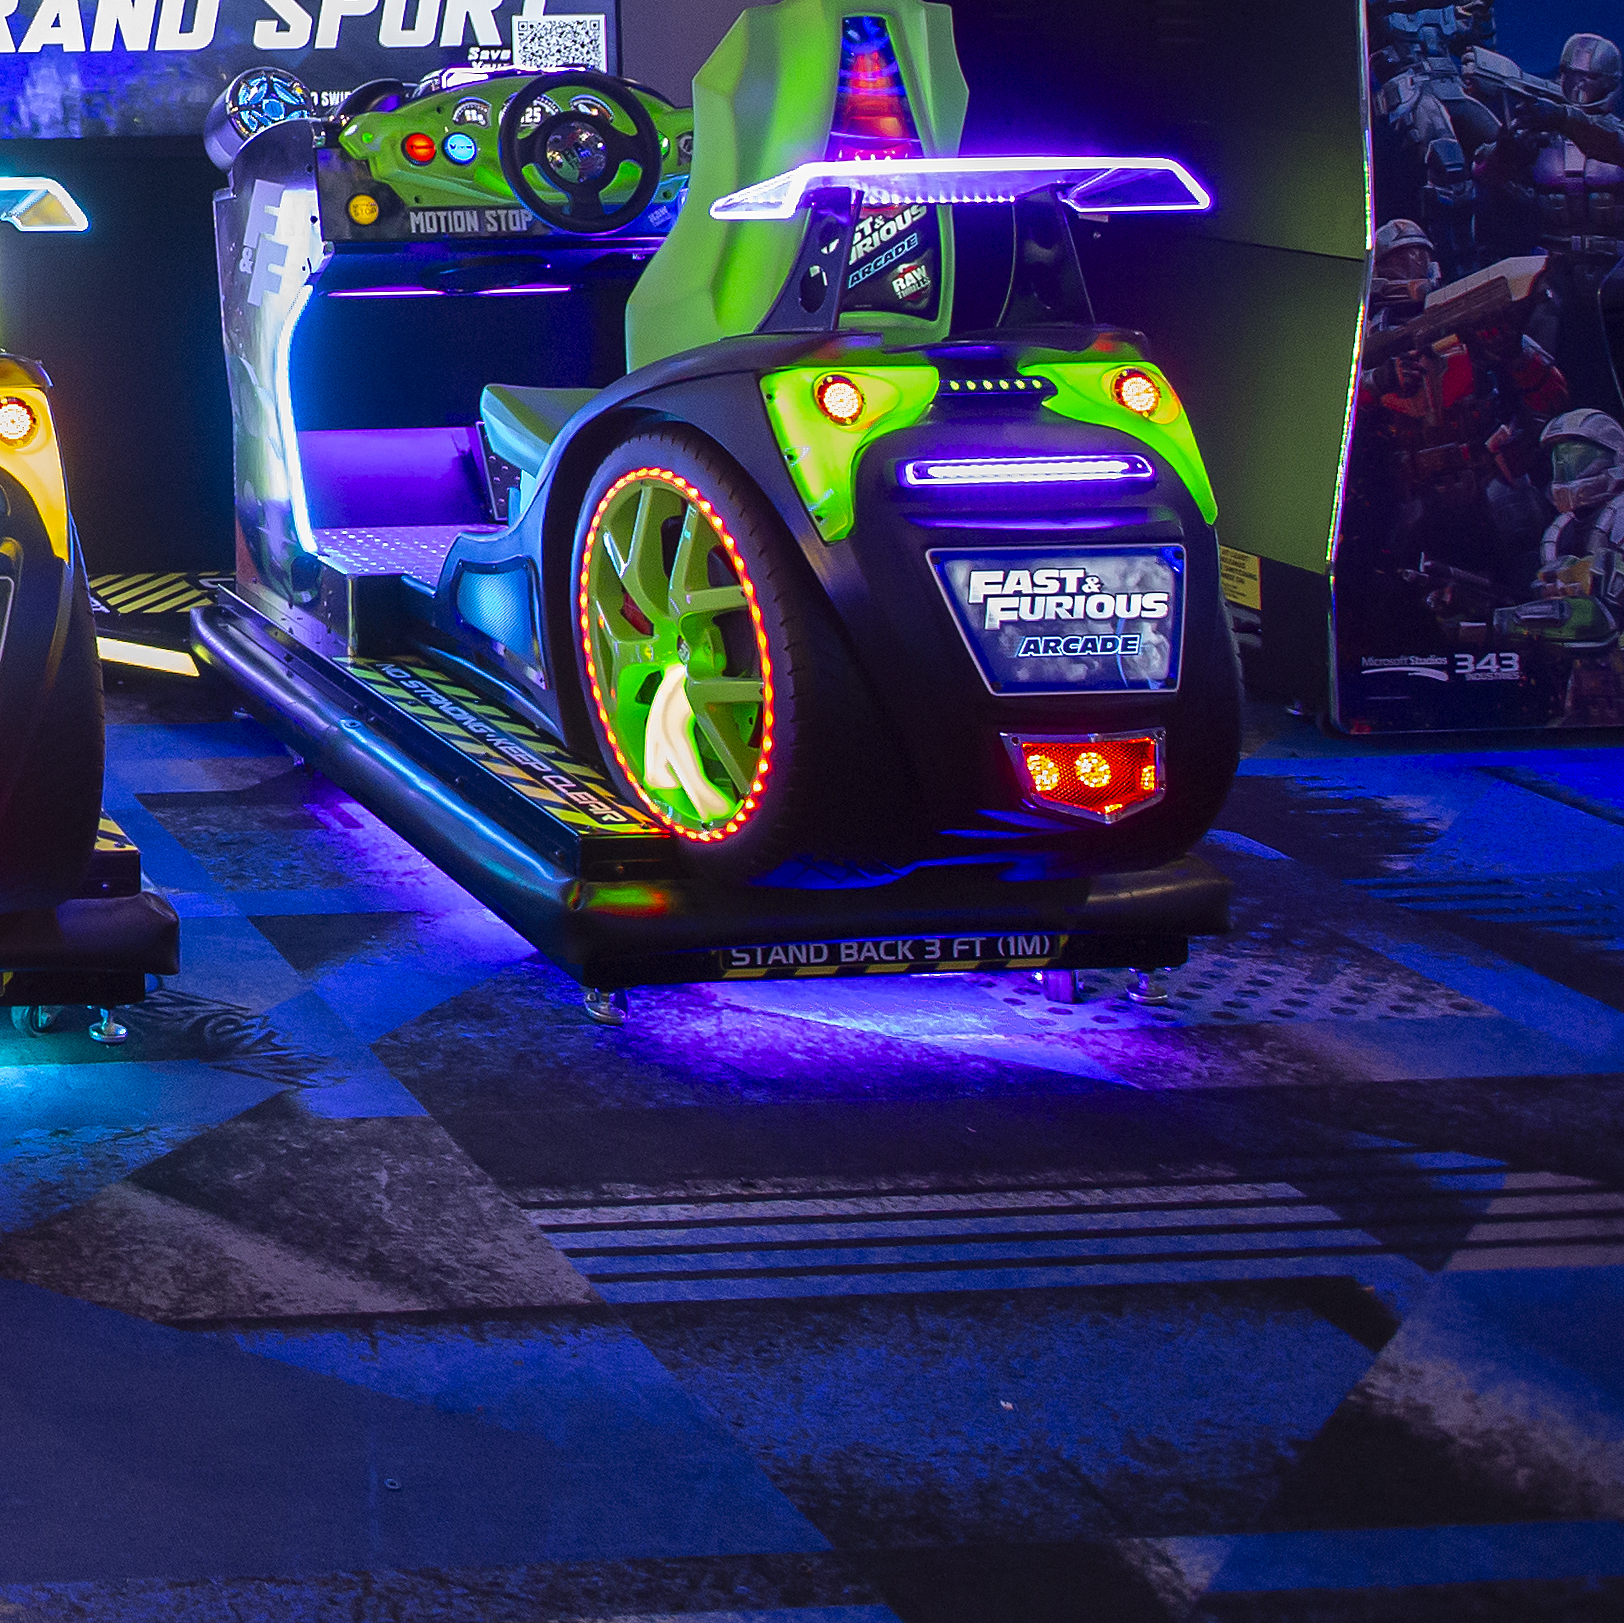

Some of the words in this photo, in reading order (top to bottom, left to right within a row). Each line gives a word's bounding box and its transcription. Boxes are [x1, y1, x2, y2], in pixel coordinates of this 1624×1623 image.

[409, 211, 480, 233] MOTION
[486, 210, 534, 233] STOP
[849, 205, 927, 265] RIOUS
[848, 233, 918, 289] ARCADE
[892, 265, 927, 292] RAW
[968, 569, 1086, 604] FAST
[985, 593, 1169, 630] FURIOUS
[1016, 635, 1141, 657] ARCADE
[1409, 654, 1449, 666] Studios
[1454, 652, 1521, 674] 343
[376, 663, 411, 679] NO
[543, 775, 627, 822] CLEAR
[731, 943, 829, 966] STAND
[840, 941, 915, 962] BACK
[924, 940, 941, 958] 3
[953, 937, 987, 958] FT
[998, 935, 1050, 956] (1M)
